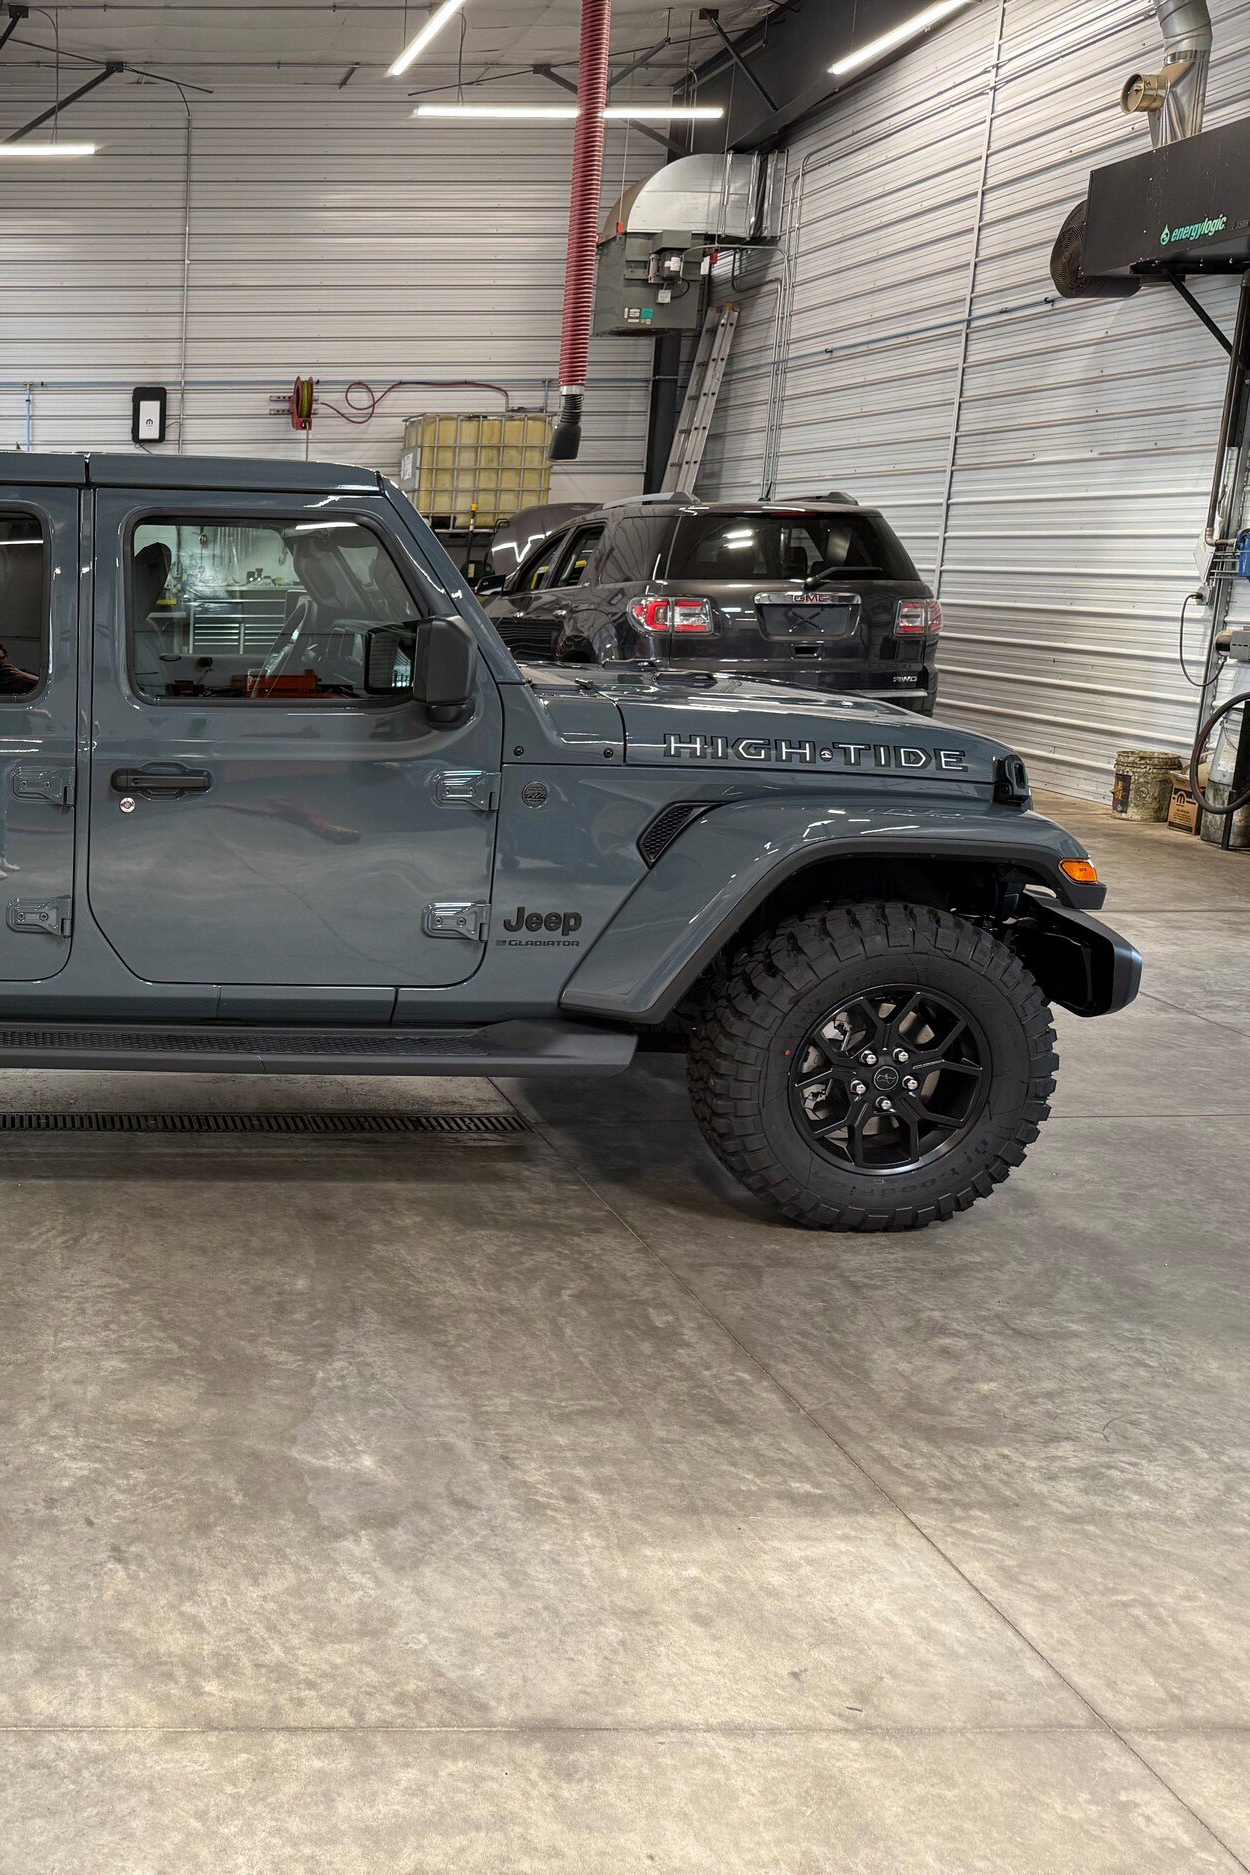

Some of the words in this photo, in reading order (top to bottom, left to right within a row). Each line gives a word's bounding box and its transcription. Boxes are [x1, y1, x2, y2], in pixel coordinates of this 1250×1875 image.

[1170, 213, 1227, 242] energylogic
[793, 592, 831, 604] GMC
[892, 675, 918, 683] AWD
[832, 741, 969, 772] TIDE
[503, 906, 583, 937] Jeep
[508, 939, 580, 947] GLADIATOR
